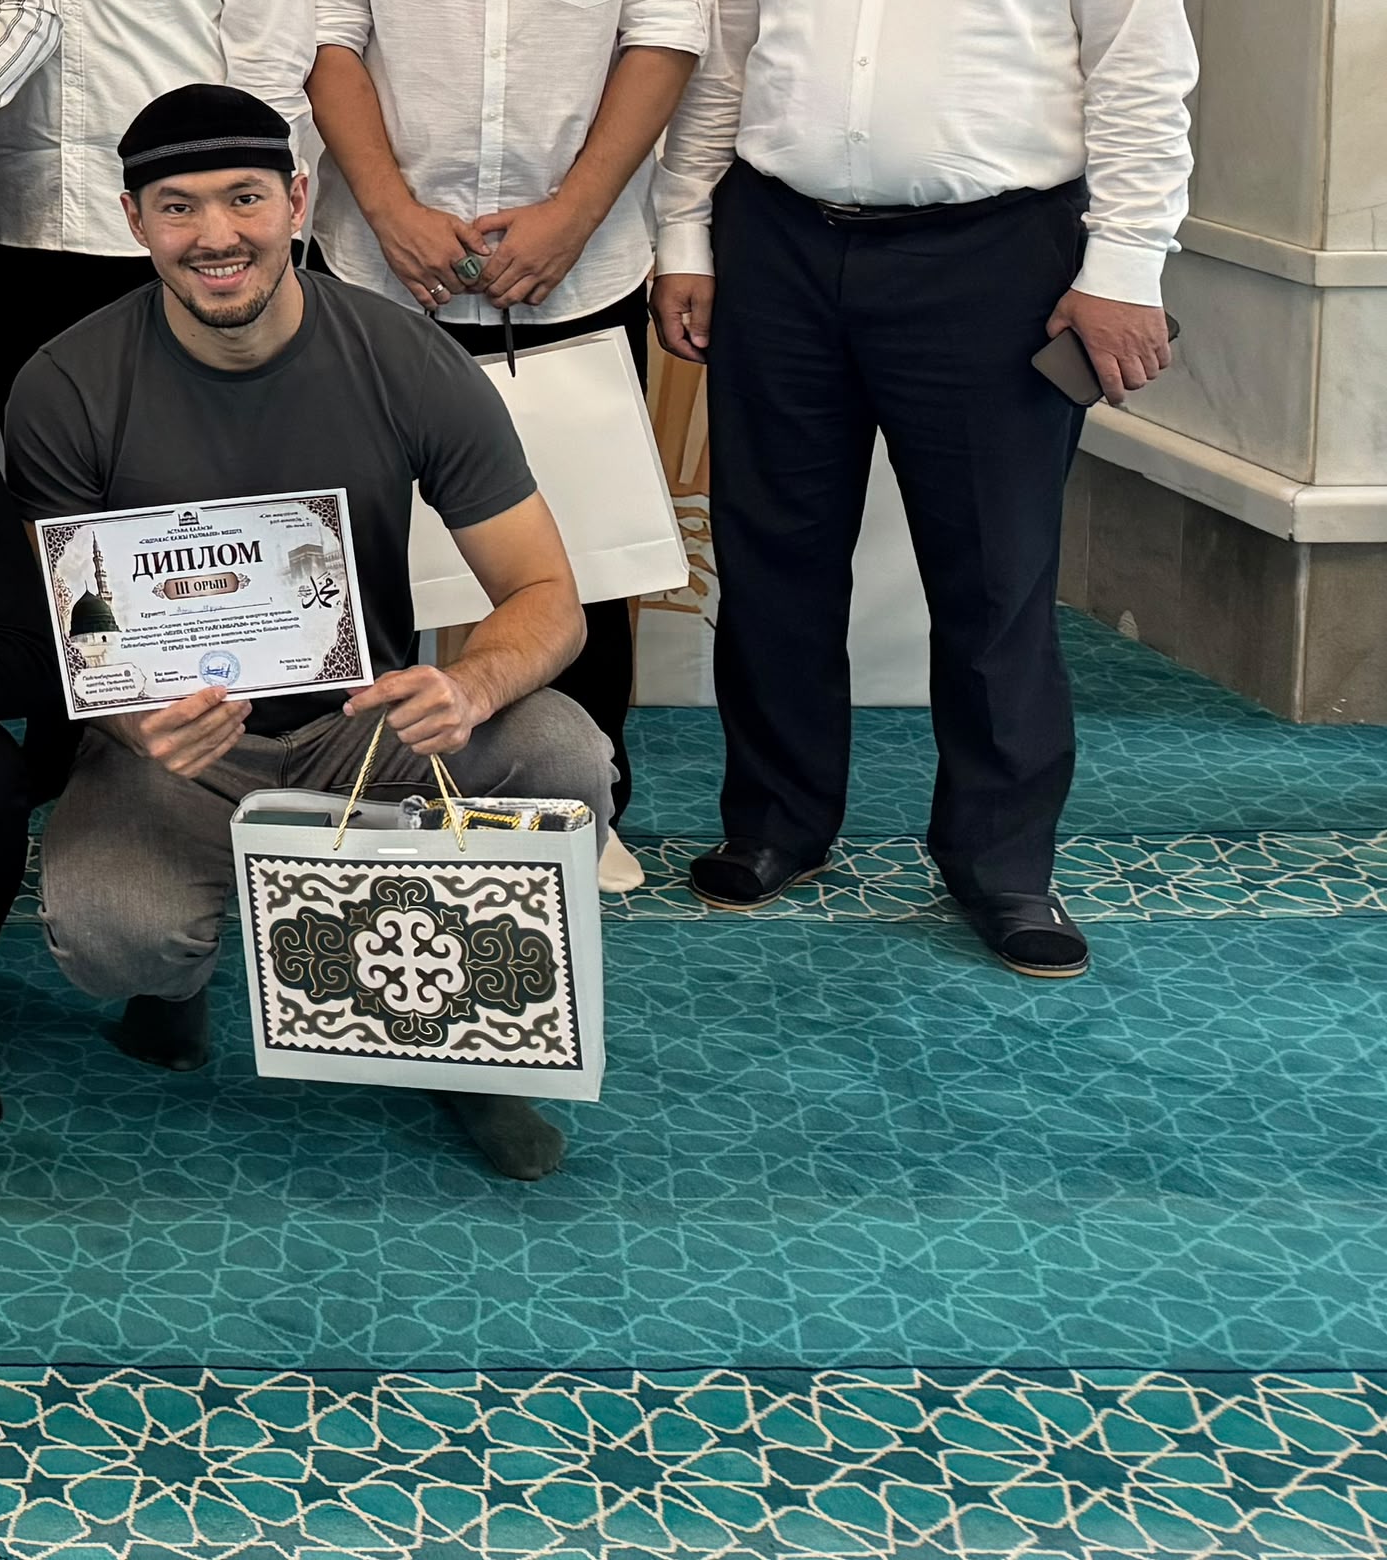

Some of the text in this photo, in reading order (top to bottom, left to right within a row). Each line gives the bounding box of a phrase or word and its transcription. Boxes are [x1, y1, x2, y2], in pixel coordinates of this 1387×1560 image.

[132, 540, 264, 583] ДИПЛОМ
[174, 578, 228, 596] III ОРЫН
